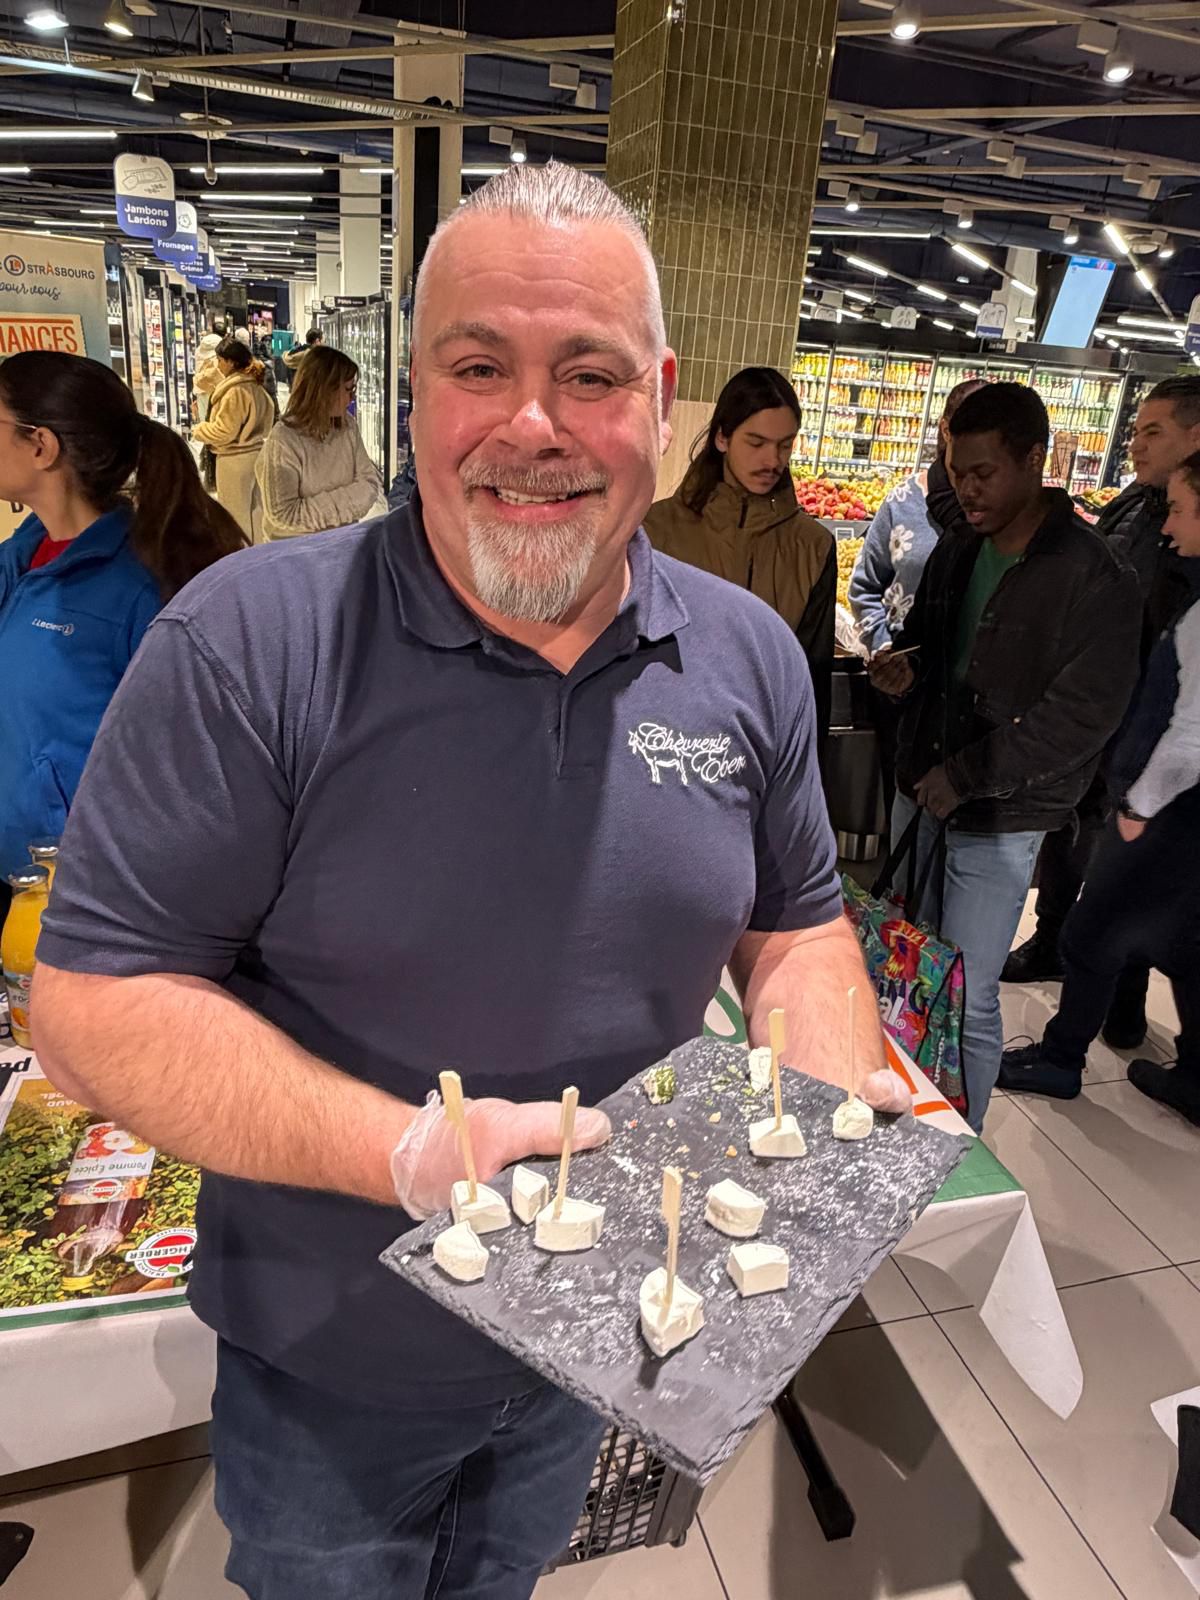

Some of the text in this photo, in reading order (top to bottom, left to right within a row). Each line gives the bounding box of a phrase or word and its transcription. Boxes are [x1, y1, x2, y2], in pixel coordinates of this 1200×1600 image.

[124, 203, 170, 218] Jambons
[127, 213, 168, 227] Lardons
[157, 239, 194, 252] Fromages
[27, 260, 96, 280] STRASBOURG
[30, 284, 61, 301] vous
[0, 324, 78, 354] ANCES
[108, 1161, 148, 1171] Pomme
[130, 1245, 193, 1260] HGERBER
